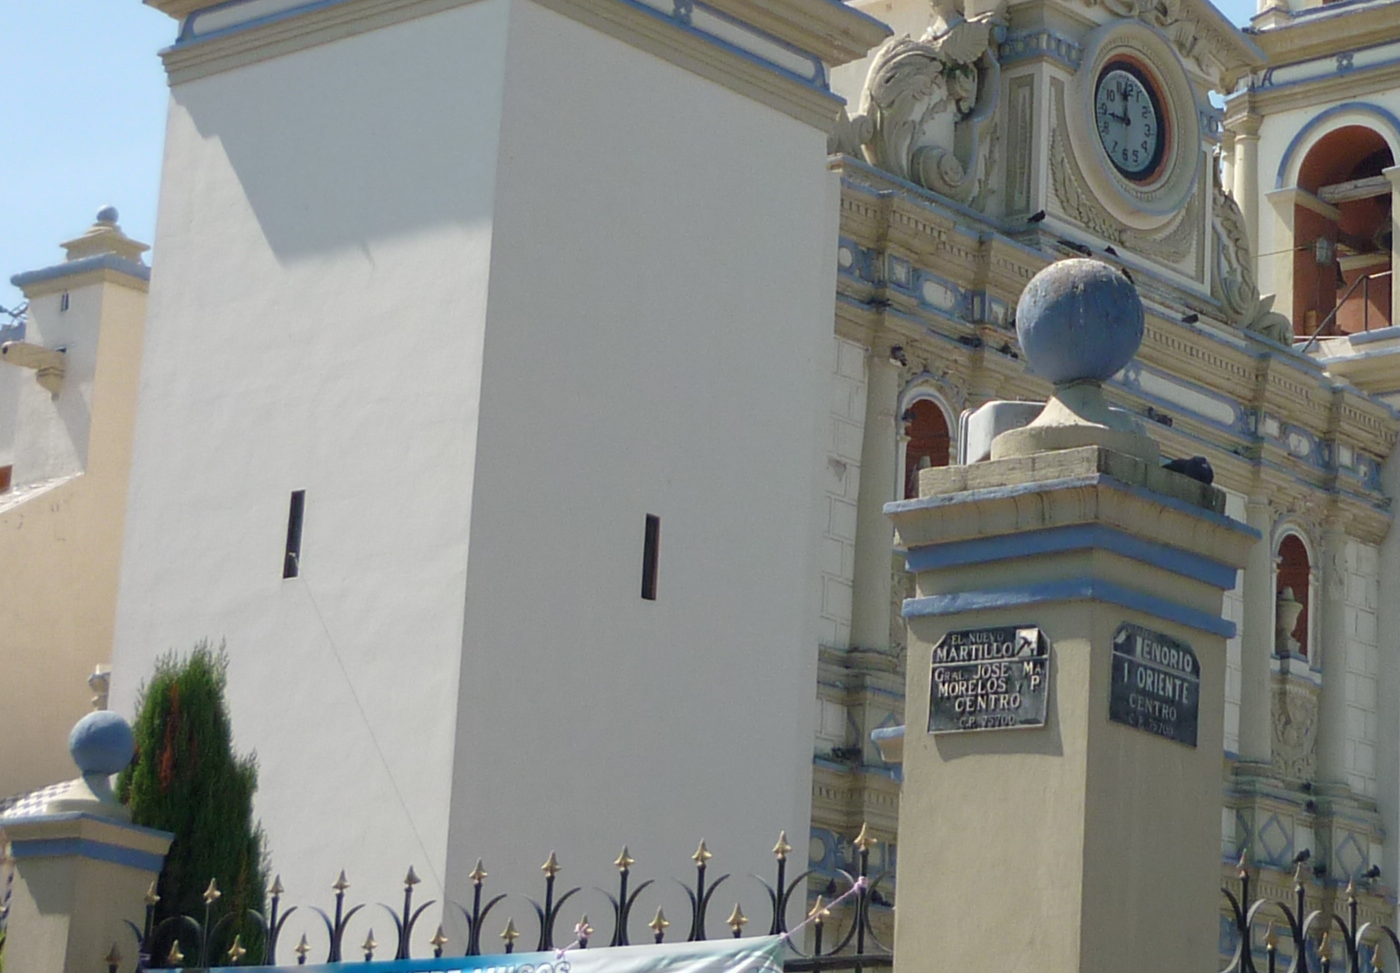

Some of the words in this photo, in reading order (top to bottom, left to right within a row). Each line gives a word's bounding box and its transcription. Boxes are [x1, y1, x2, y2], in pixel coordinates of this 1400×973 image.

[1106, 88, 1115, 102] 10
[1136, 90, 1142, 103] 1
[1101, 102, 1107, 116] 9
[1142, 105, 1148, 119] 2
[1144, 124, 1151, 138] 3
[1110, 140, 1118, 154] 7
[1140, 140, 1148, 154] 4
[1122, 148, 1128, 162] 6
[1132, 149, 1139, 163] 5
[952, 634, 963, 645] EL
[968, 631, 1004, 644] NUEVO
[935, 642, 1012, 662] MARTILLO
[973, 662, 1010, 679] JOSE
[938, 677, 1007, 698] MORELOS
[1137, 667, 1189, 704] ORIENTE
[954, 692, 1021, 713] CENTRO
[1129, 693, 1177, 721] CENTRO
[981, 713, 1016, 727] 75700
